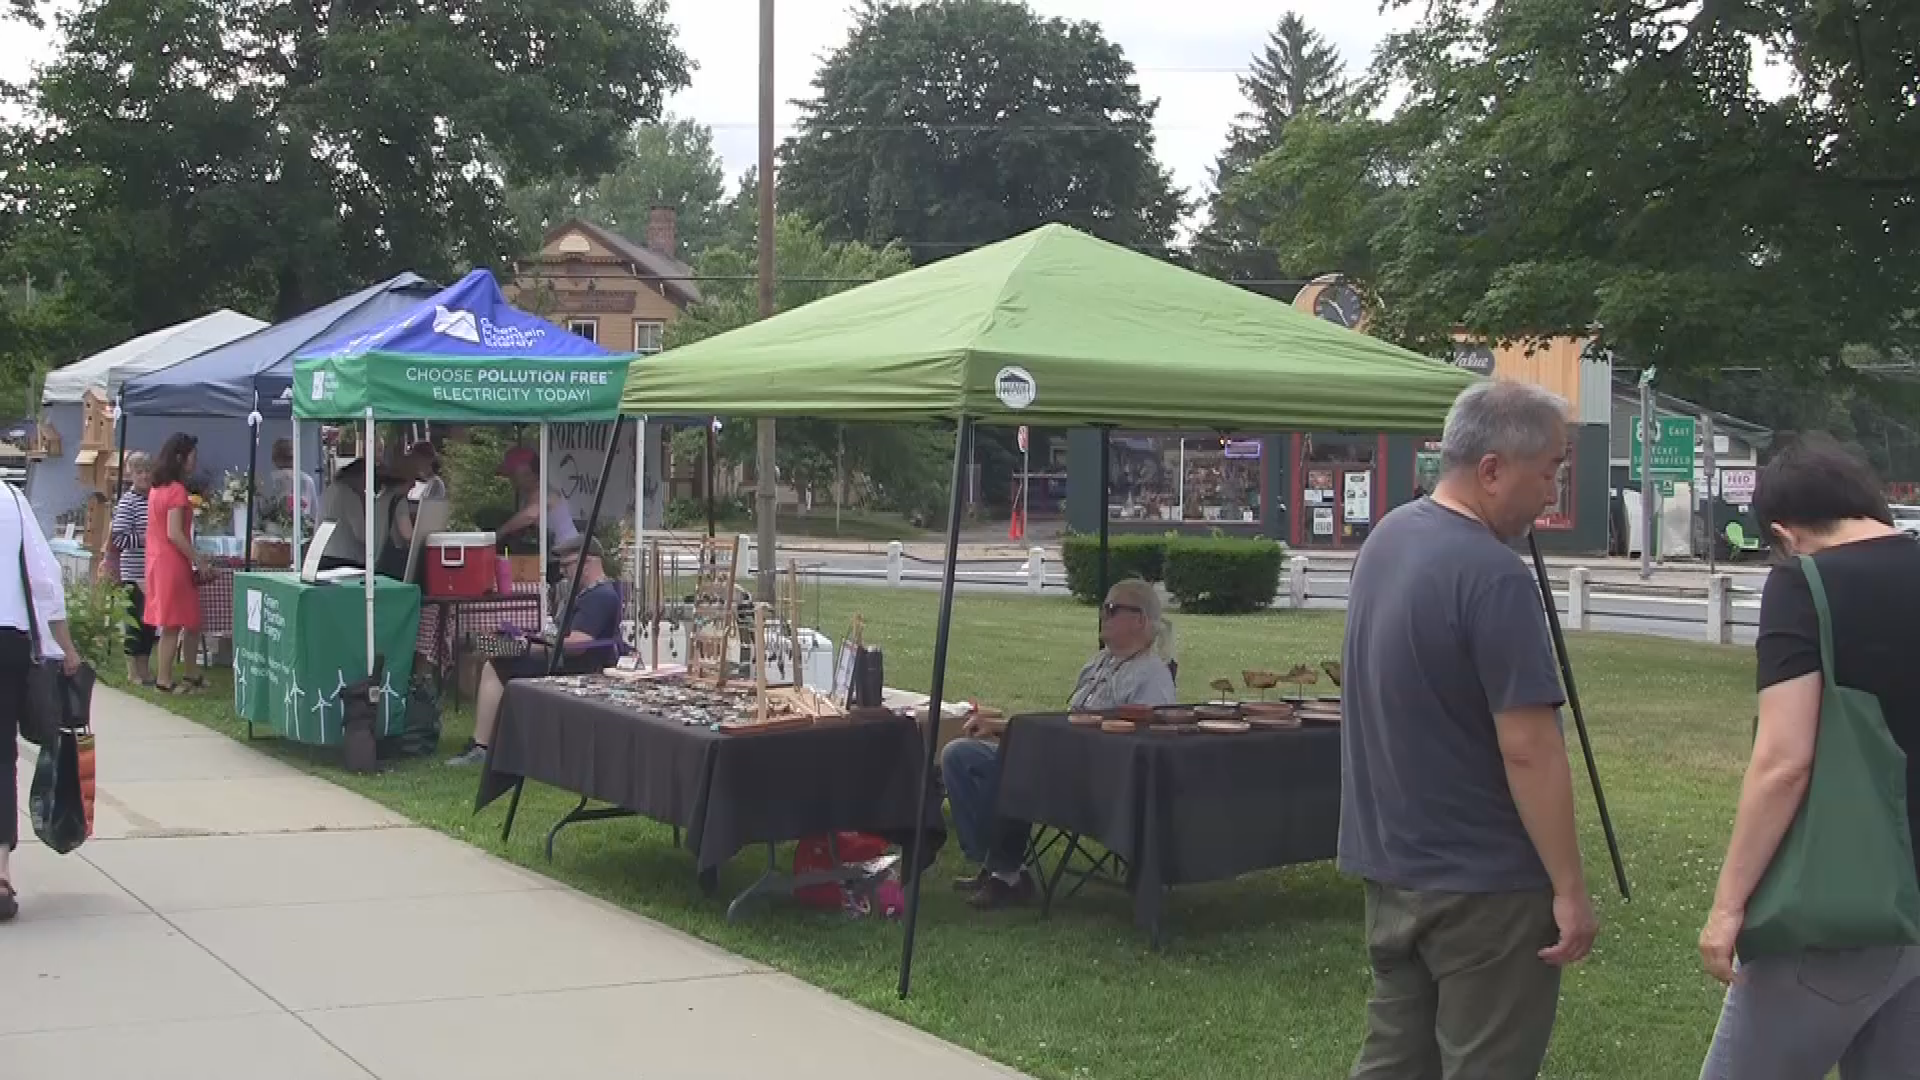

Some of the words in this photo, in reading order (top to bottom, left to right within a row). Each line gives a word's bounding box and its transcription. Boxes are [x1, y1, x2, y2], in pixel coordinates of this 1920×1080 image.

[406, 367, 473, 383] CHOOSE
[478, 369, 565, 384] POLLUTION
[433, 386, 530, 401] ELECTRICITY
[536, 387, 591, 402] TODAY!
